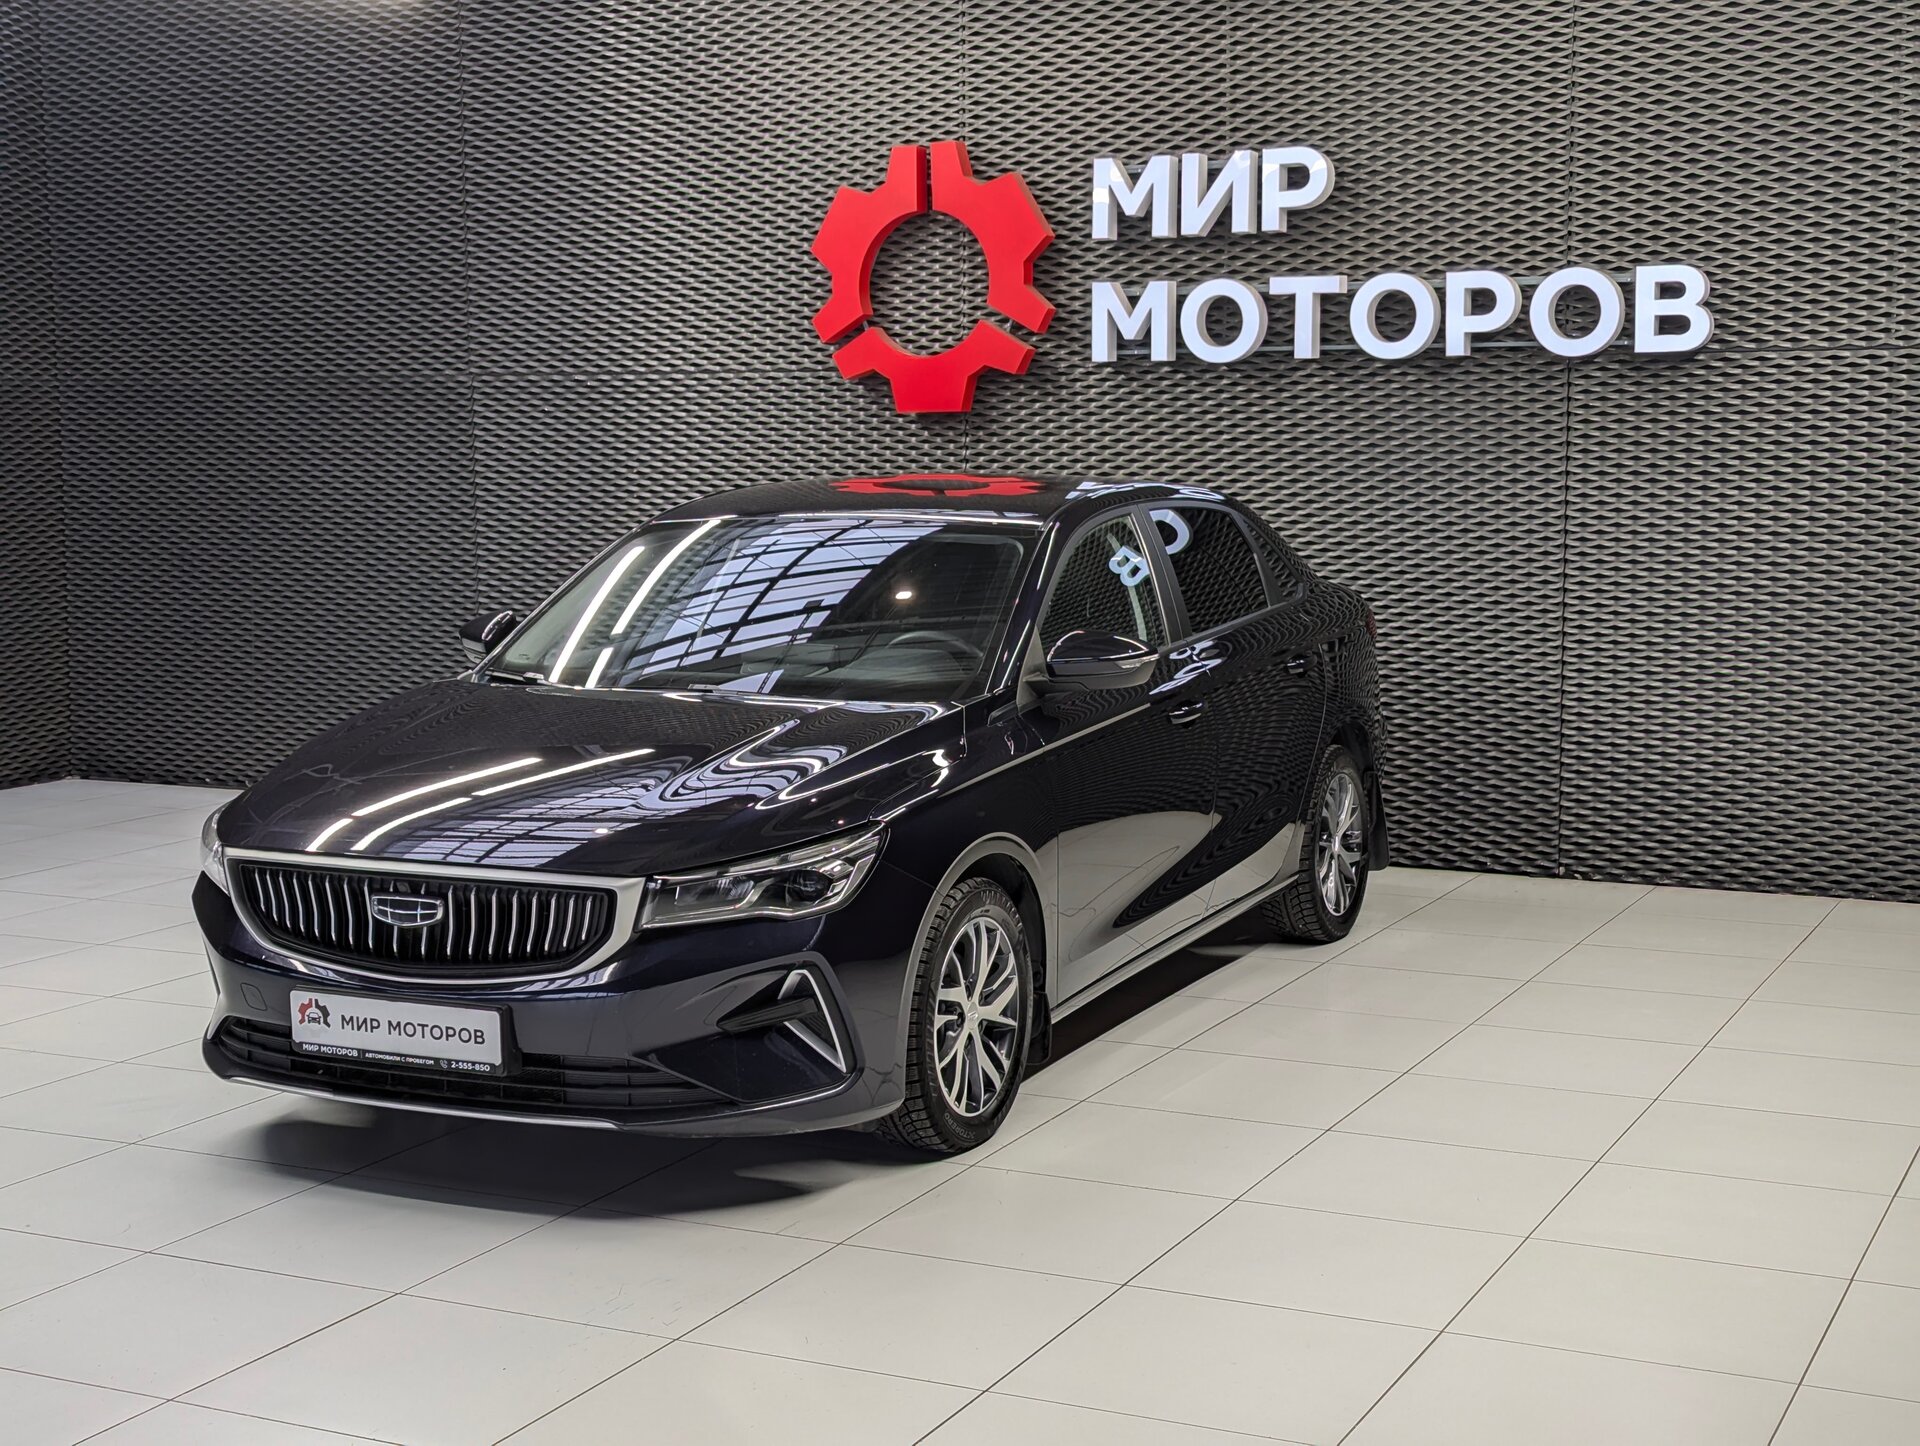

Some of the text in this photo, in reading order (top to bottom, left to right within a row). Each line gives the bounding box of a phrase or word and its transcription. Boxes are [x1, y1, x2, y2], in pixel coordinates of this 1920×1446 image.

[1091, 145, 1335, 240] МИР
[1091, 264, 1714, 364] МОТОРОВ
[341, 1014, 486, 1045] МИР МОТОРОВ
[303, 1043, 358, 1057] МИР МОТОРОВ
[365, 1052, 400, 1062] АВТОМОБИЛИ
[406, 1057, 435, 1066] ПРОБЕГОМ
[451, 1061, 490, 1072] 2-555-850
